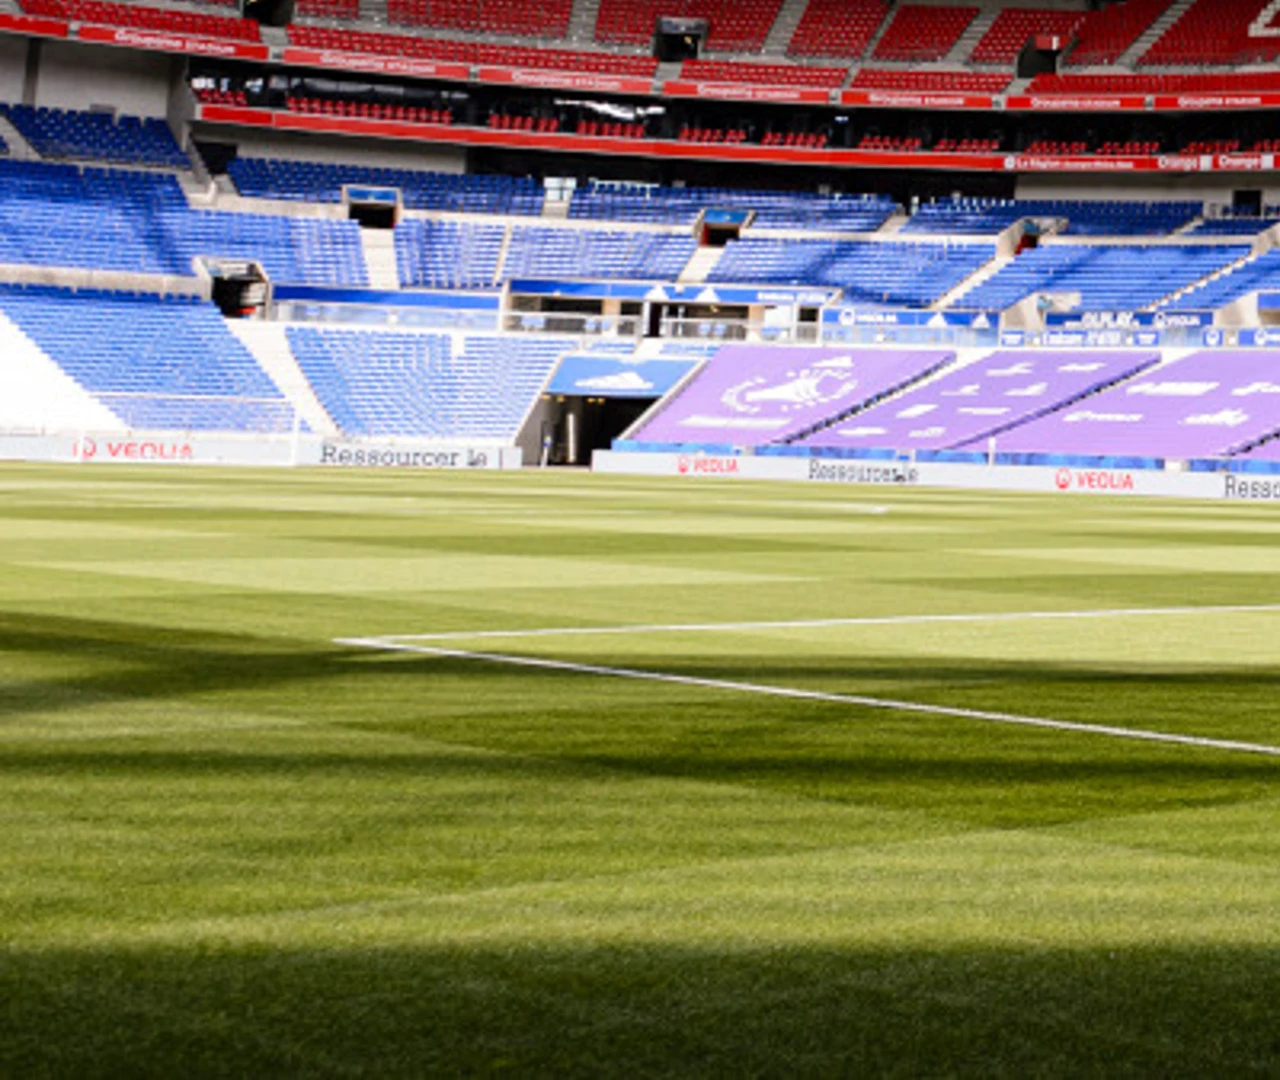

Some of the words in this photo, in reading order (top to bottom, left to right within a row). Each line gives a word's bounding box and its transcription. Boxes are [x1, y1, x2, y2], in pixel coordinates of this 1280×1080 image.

[319, 444, 459, 467] Ressourcer
[467, 448, 488, 467] le
[1076, 471, 1134, 490] VEOLIA
